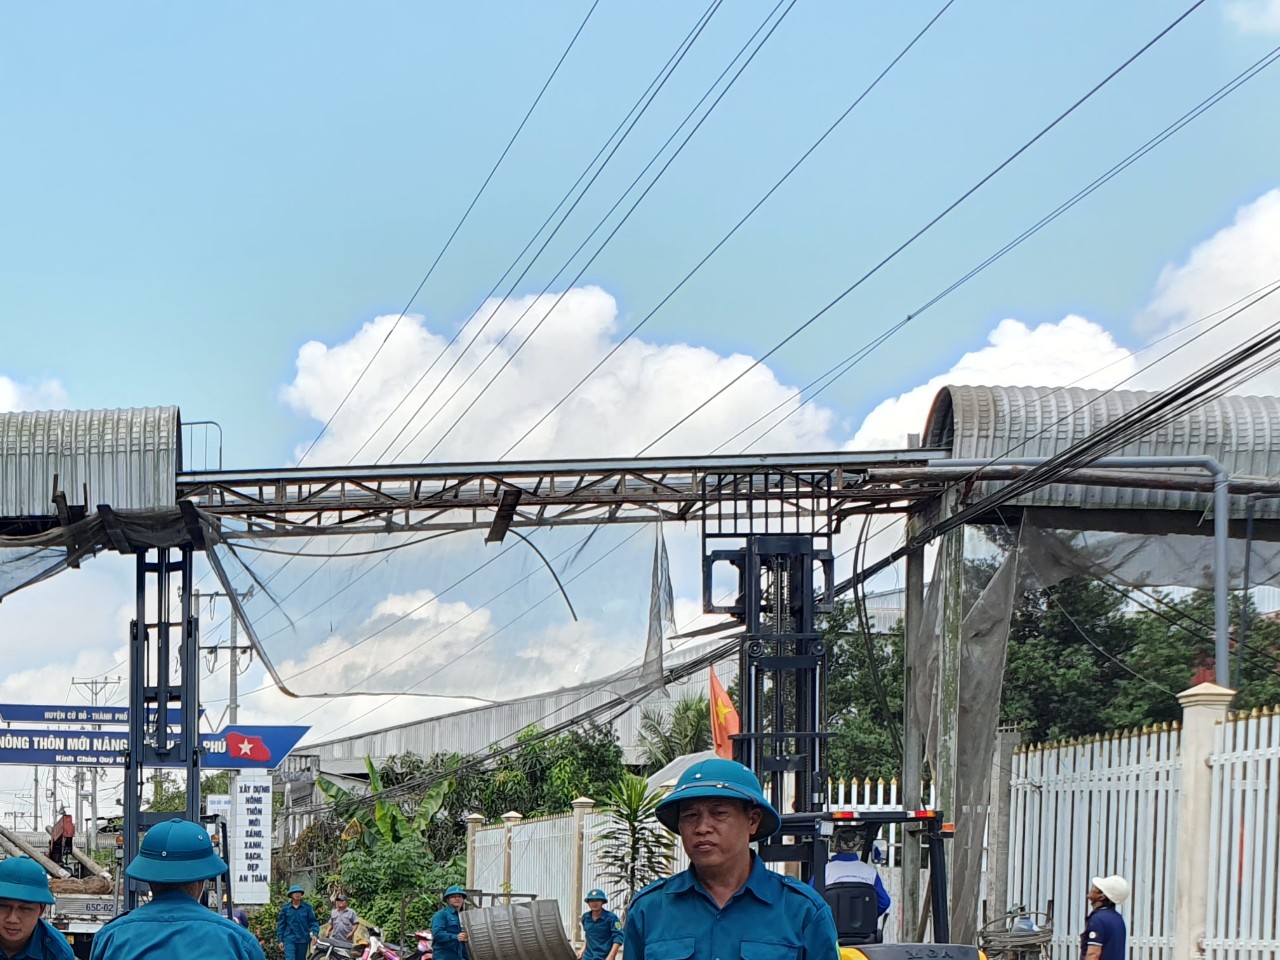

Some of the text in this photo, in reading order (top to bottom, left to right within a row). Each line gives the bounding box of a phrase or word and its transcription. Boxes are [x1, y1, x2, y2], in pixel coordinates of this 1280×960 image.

[44, 710, 65, 721] HUYỆN
[67, 710, 76, 720] CỜ
[92, 711, 112, 720] THÀNH
[115, 711, 128, 721] PHỐ
[33, 735, 64, 750] THÔN
[67, 735, 90, 751] MỚI
[93, 736, 128, 752] NÂNG
[203, 738, 227, 753] PHÚ
[77, 755, 97, 763] Chào
[99, 756, 114, 764] Quý
[239, 784, 251, 793] XÂY
[245, 795, 262, 804] NÔNG
[246, 806, 262, 816] THÔN
[239, 873, 268, 883] AN TOÀN
